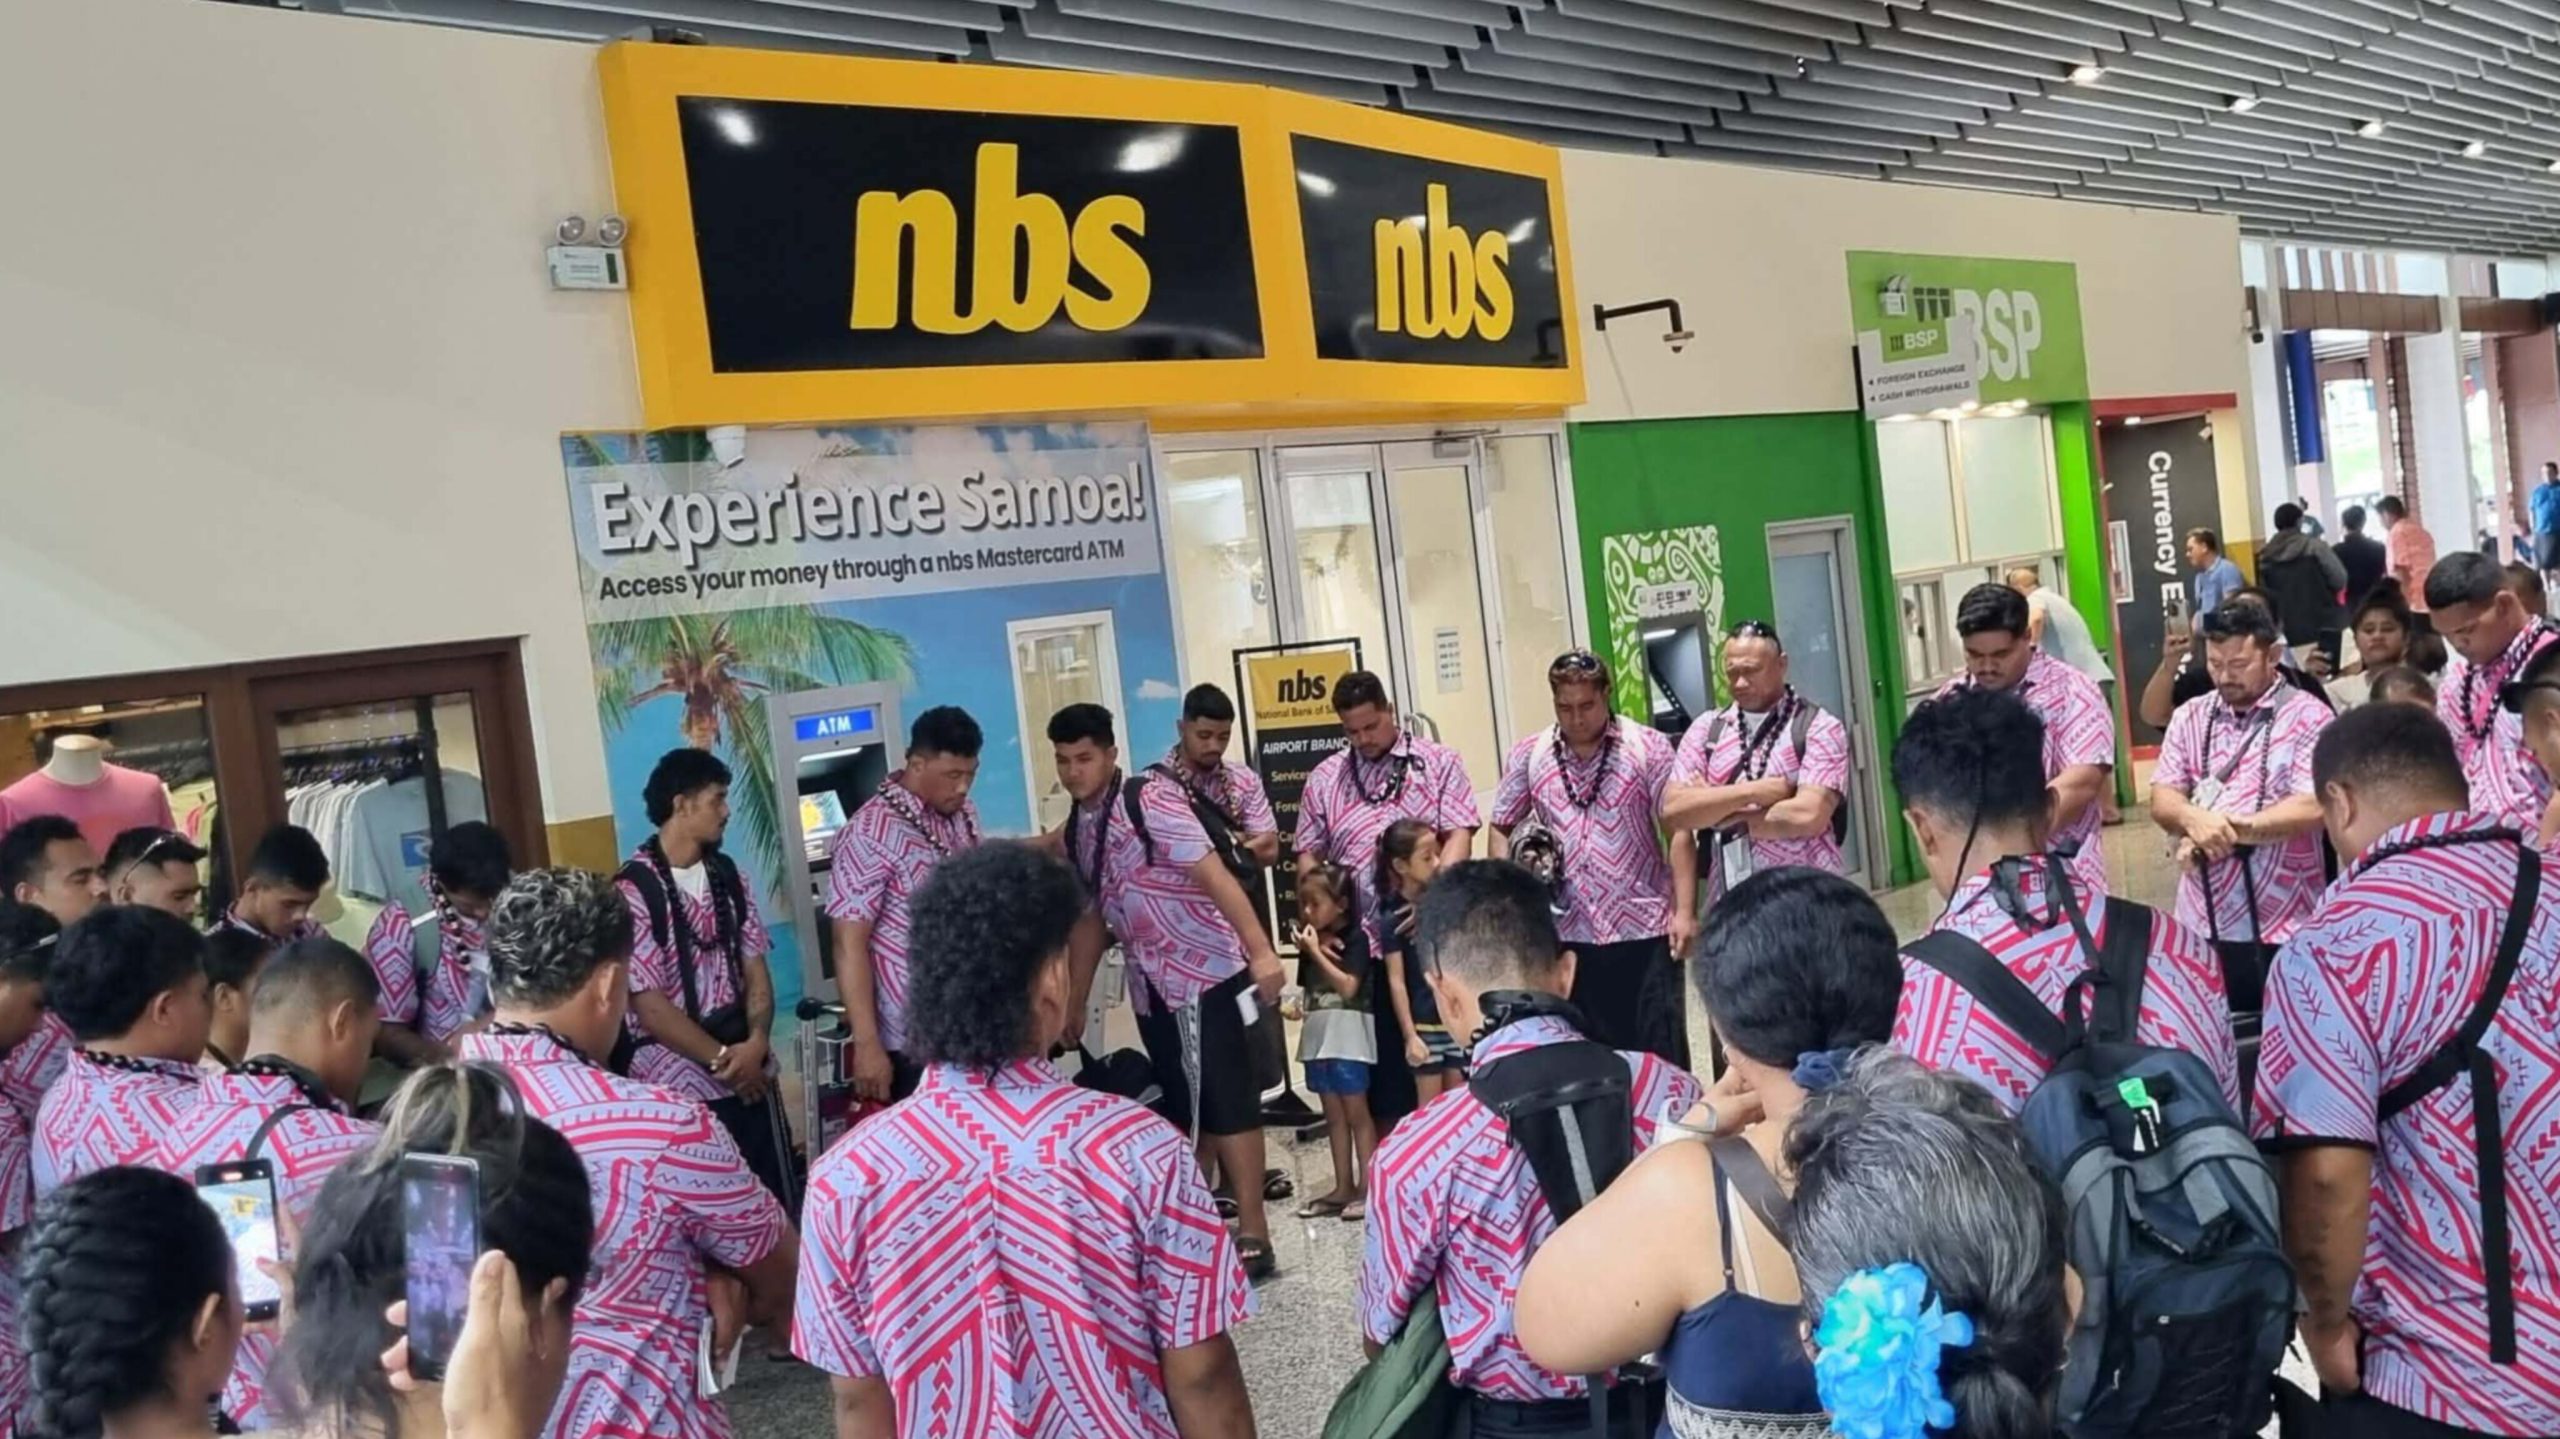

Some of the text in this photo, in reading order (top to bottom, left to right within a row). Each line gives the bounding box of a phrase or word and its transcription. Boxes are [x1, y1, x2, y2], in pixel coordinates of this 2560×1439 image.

[850, 142, 1151, 335] nbs
[1374, 184, 1514, 342] nbs
[1904, 329, 1938, 350] BSP
[1953, 288, 2042, 382] BSP
[1877, 364, 1966, 386] FOREIGN EXCHANGE
[1879, 380, 1971, 402] CASH WITHDRAWALS
[590, 461, 1145, 570] Experience Samoa!
[2148, 451, 2178, 575] Currency
[600, 539, 1124, 600] Access your money through a nbs Mastercard ATM
[1278, 668, 1326, 703] nbs
[817, 715, 851, 736] ATM
[1256, 708, 1290, 720] National
[1292, 706, 1314, 717] Bank
[1316, 704, 1324, 714] of
[1262, 737, 1351, 755] AIRPORT BRANC
